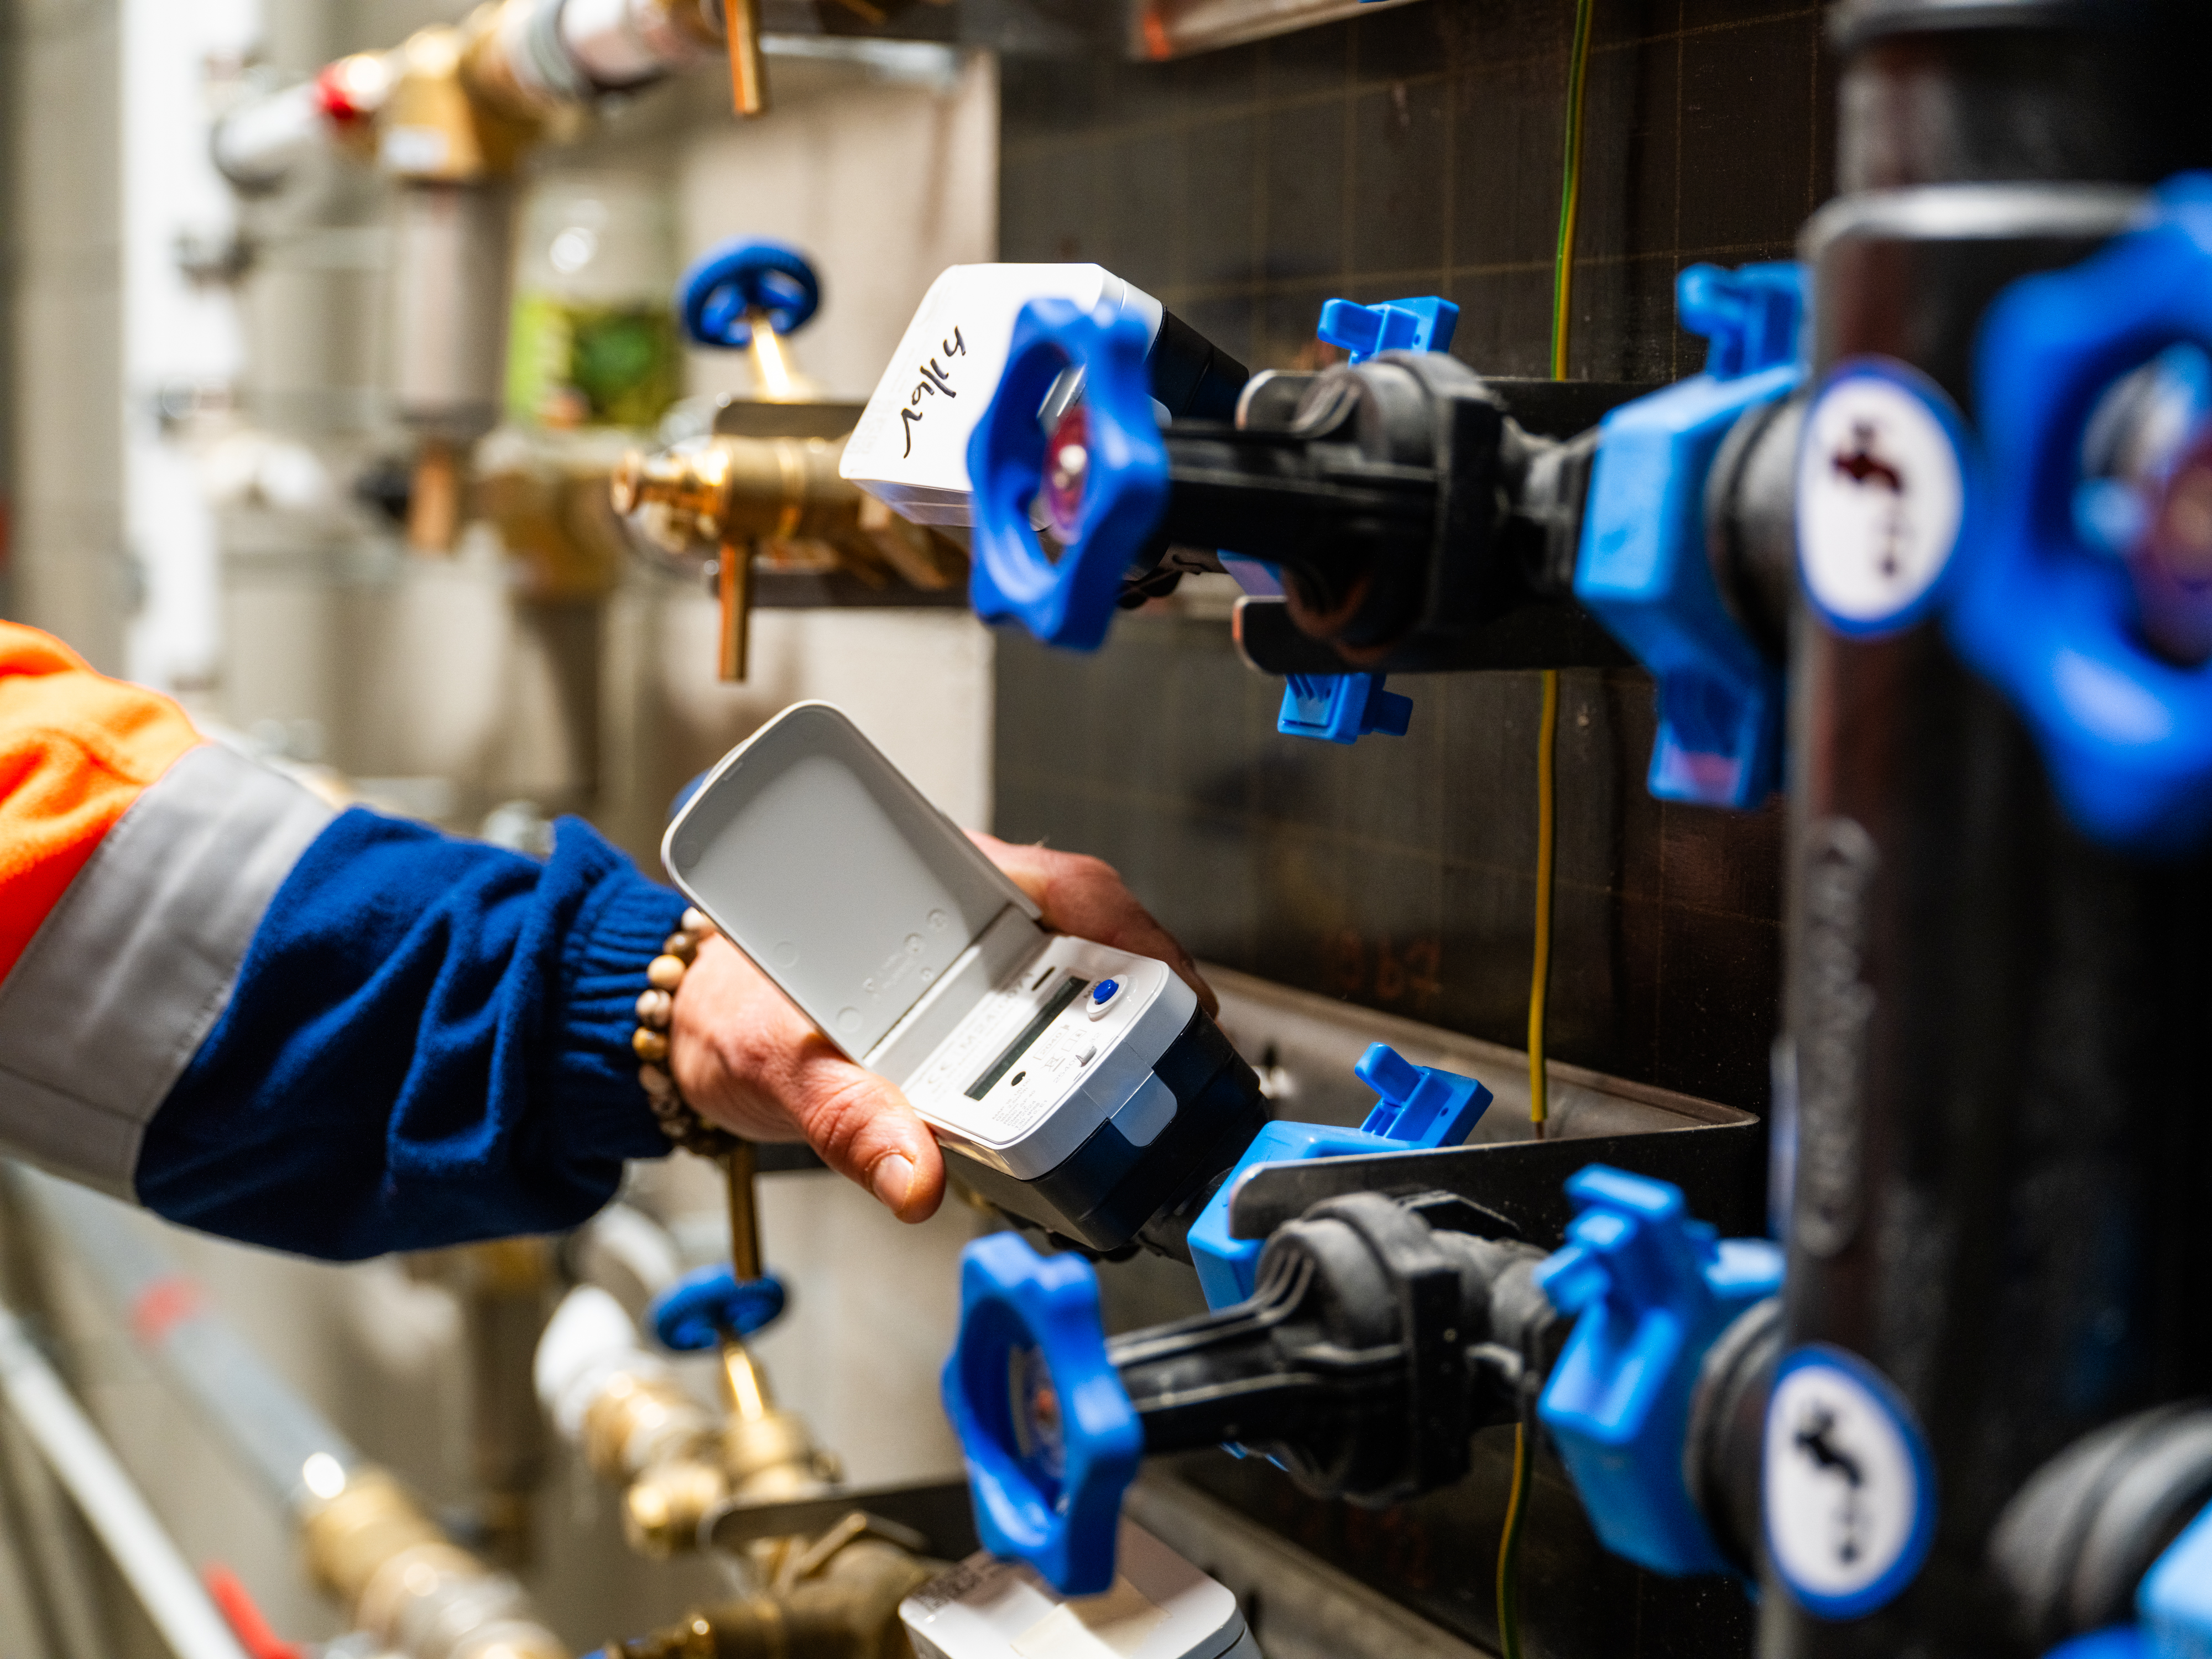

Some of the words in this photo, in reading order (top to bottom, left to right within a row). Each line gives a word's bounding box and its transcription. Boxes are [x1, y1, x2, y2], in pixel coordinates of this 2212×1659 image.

[1039, 1032, 1062, 1055] 2040
[992, 1106, 1005, 1119] MAP
[1006, 1110, 1022, 1126] Class
[1018, 1115, 1034, 1131] Class
